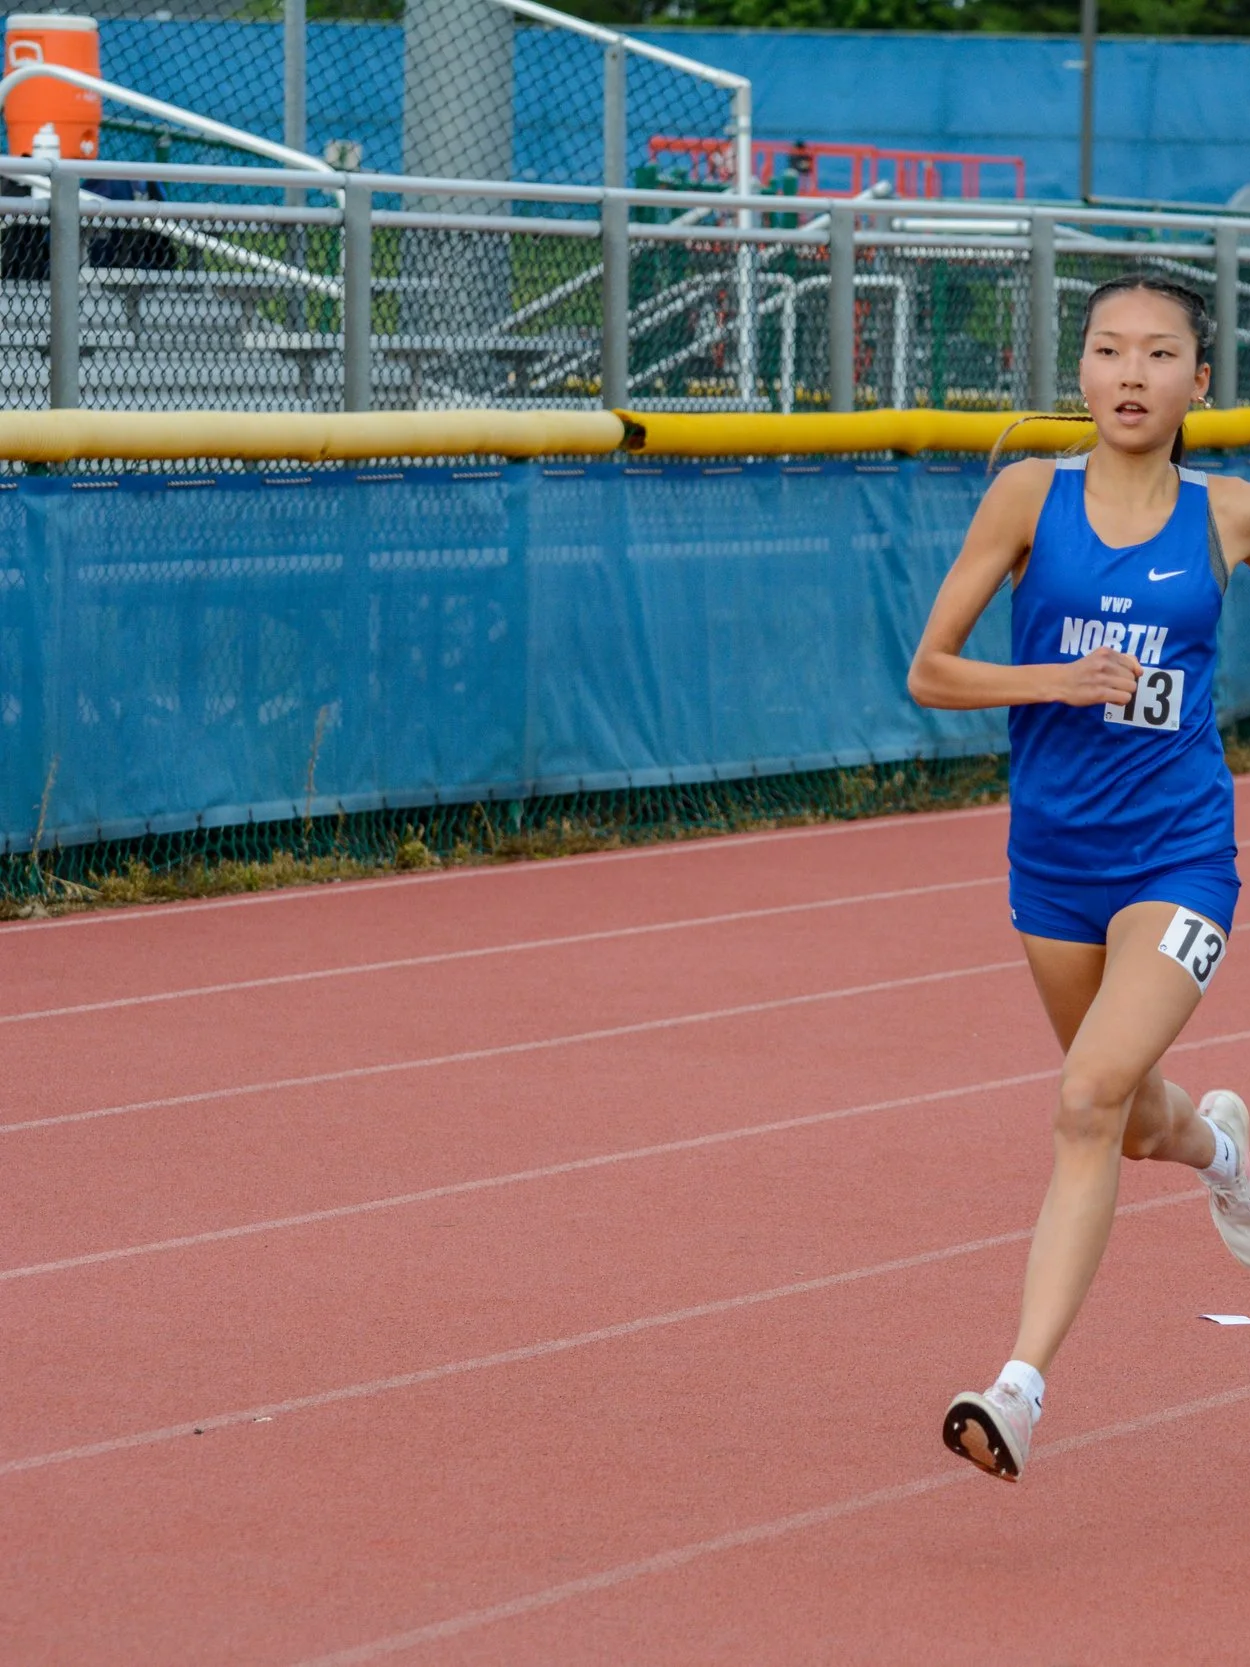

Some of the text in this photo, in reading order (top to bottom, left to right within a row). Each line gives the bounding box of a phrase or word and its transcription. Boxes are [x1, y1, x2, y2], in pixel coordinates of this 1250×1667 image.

[1101, 596, 1132, 613] WWP
[1060, 617, 1168, 664] NORTH
[1176, 918, 1222, 982] 13
